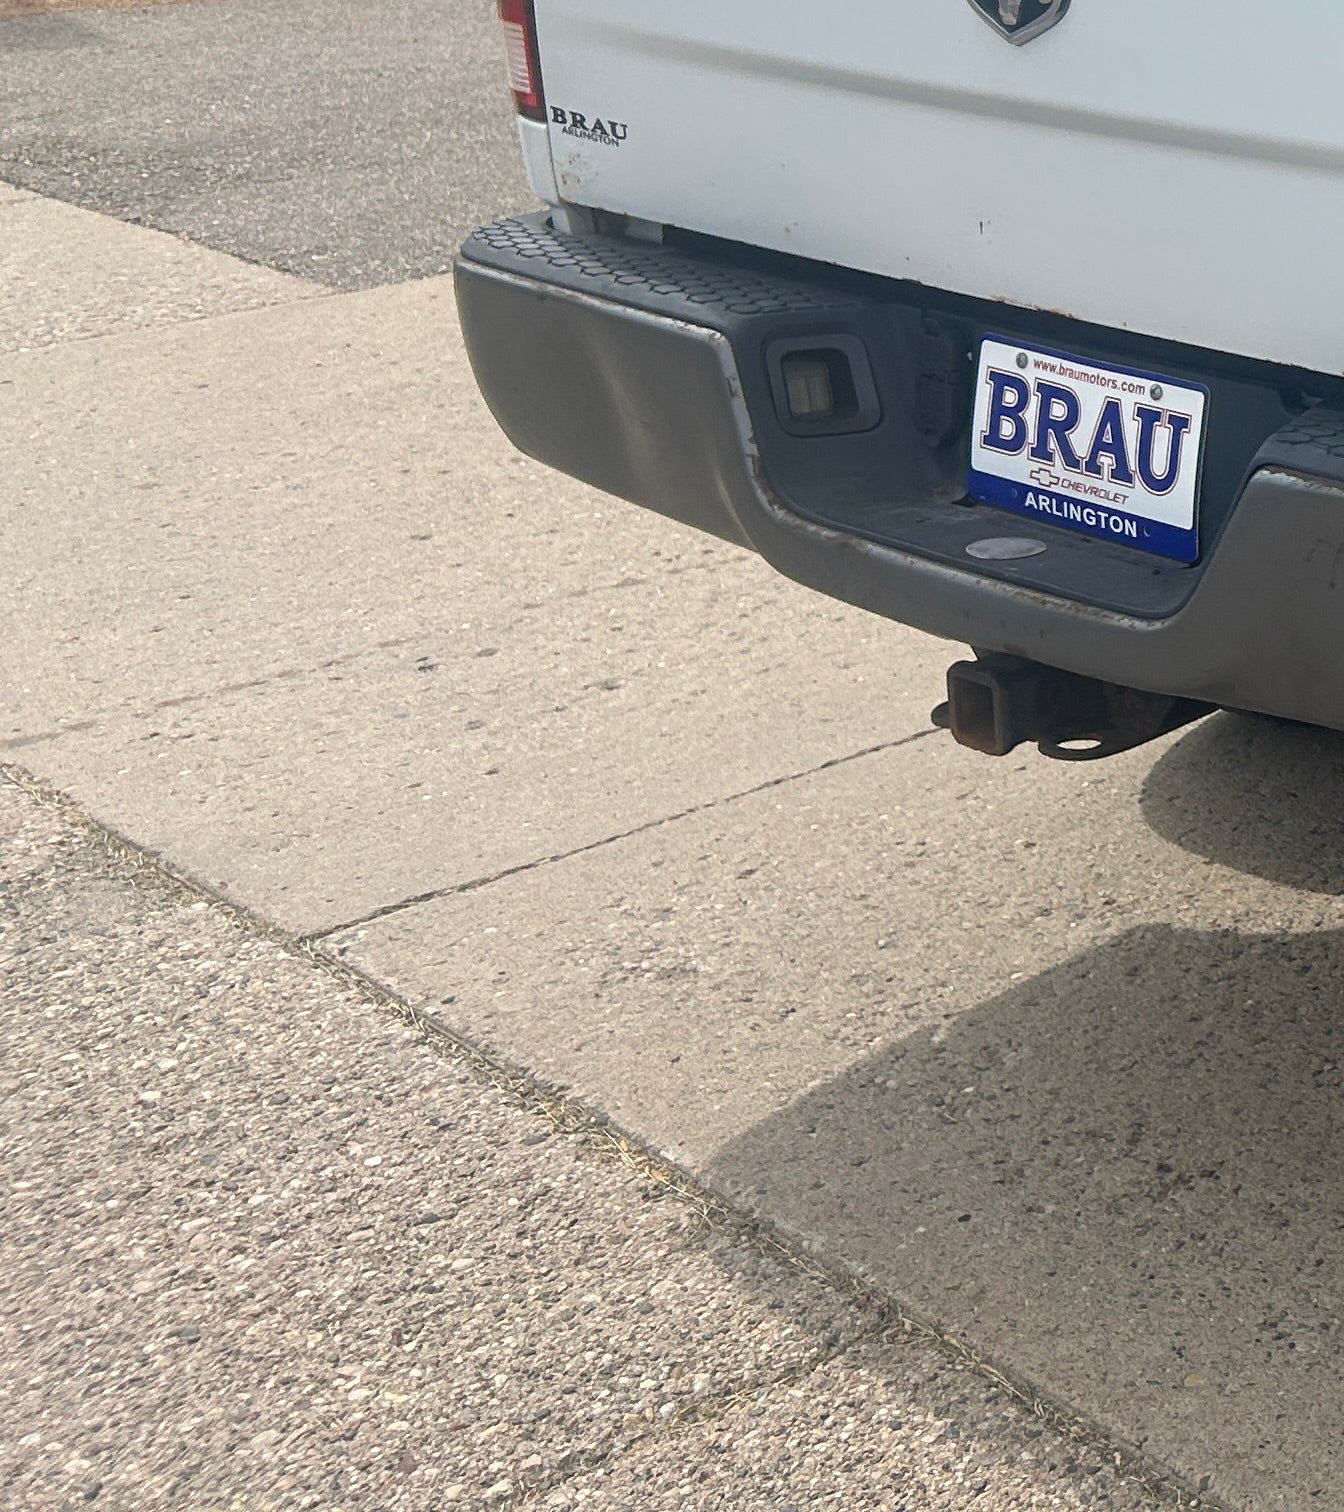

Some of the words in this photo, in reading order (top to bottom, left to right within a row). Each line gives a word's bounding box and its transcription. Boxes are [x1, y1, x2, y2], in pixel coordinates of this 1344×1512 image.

[549, 105, 628, 140] BRAU
[561, 126, 620, 147] ARLINGTON
[1033, 358, 1146, 395] www.braumotors.com
[979, 366, 1193, 496] BRAU
[1060, 478, 1130, 505] CHEVROLET
[1024, 491, 1138, 538] ARLINGTON
